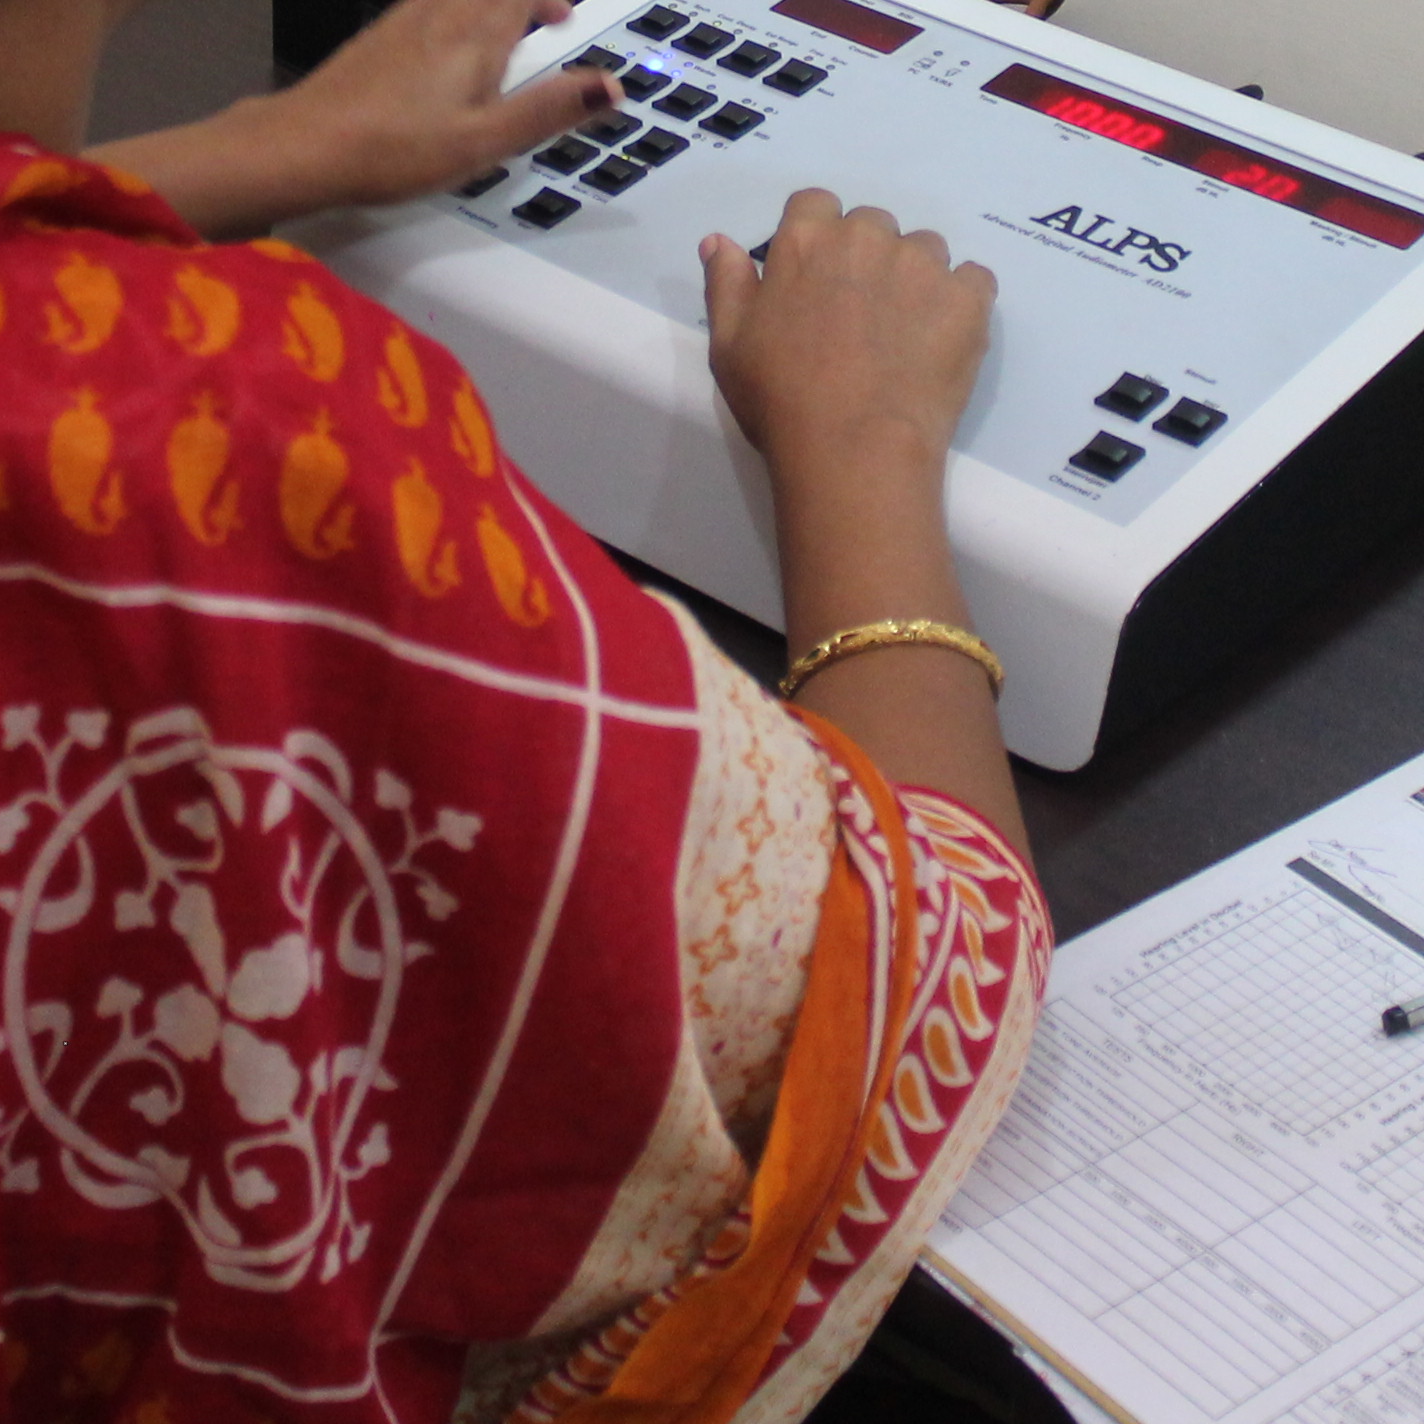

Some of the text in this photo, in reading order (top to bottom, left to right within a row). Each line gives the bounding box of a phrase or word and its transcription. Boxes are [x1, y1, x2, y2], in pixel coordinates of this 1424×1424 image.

[1046, 96, 1166, 150] 1000
[979, 211, 1036, 237] Advanced
[1033, 231, 1075, 254] Digital
[1075, 249, 1139, 279] Audiometer
[1029, 205, 1192, 274] ALPS
[1048, 473, 1091, 498] Channel
[1099, 1038, 1135, 1063] TESTS
[1229, 1132, 1265, 1158] RIGHT
